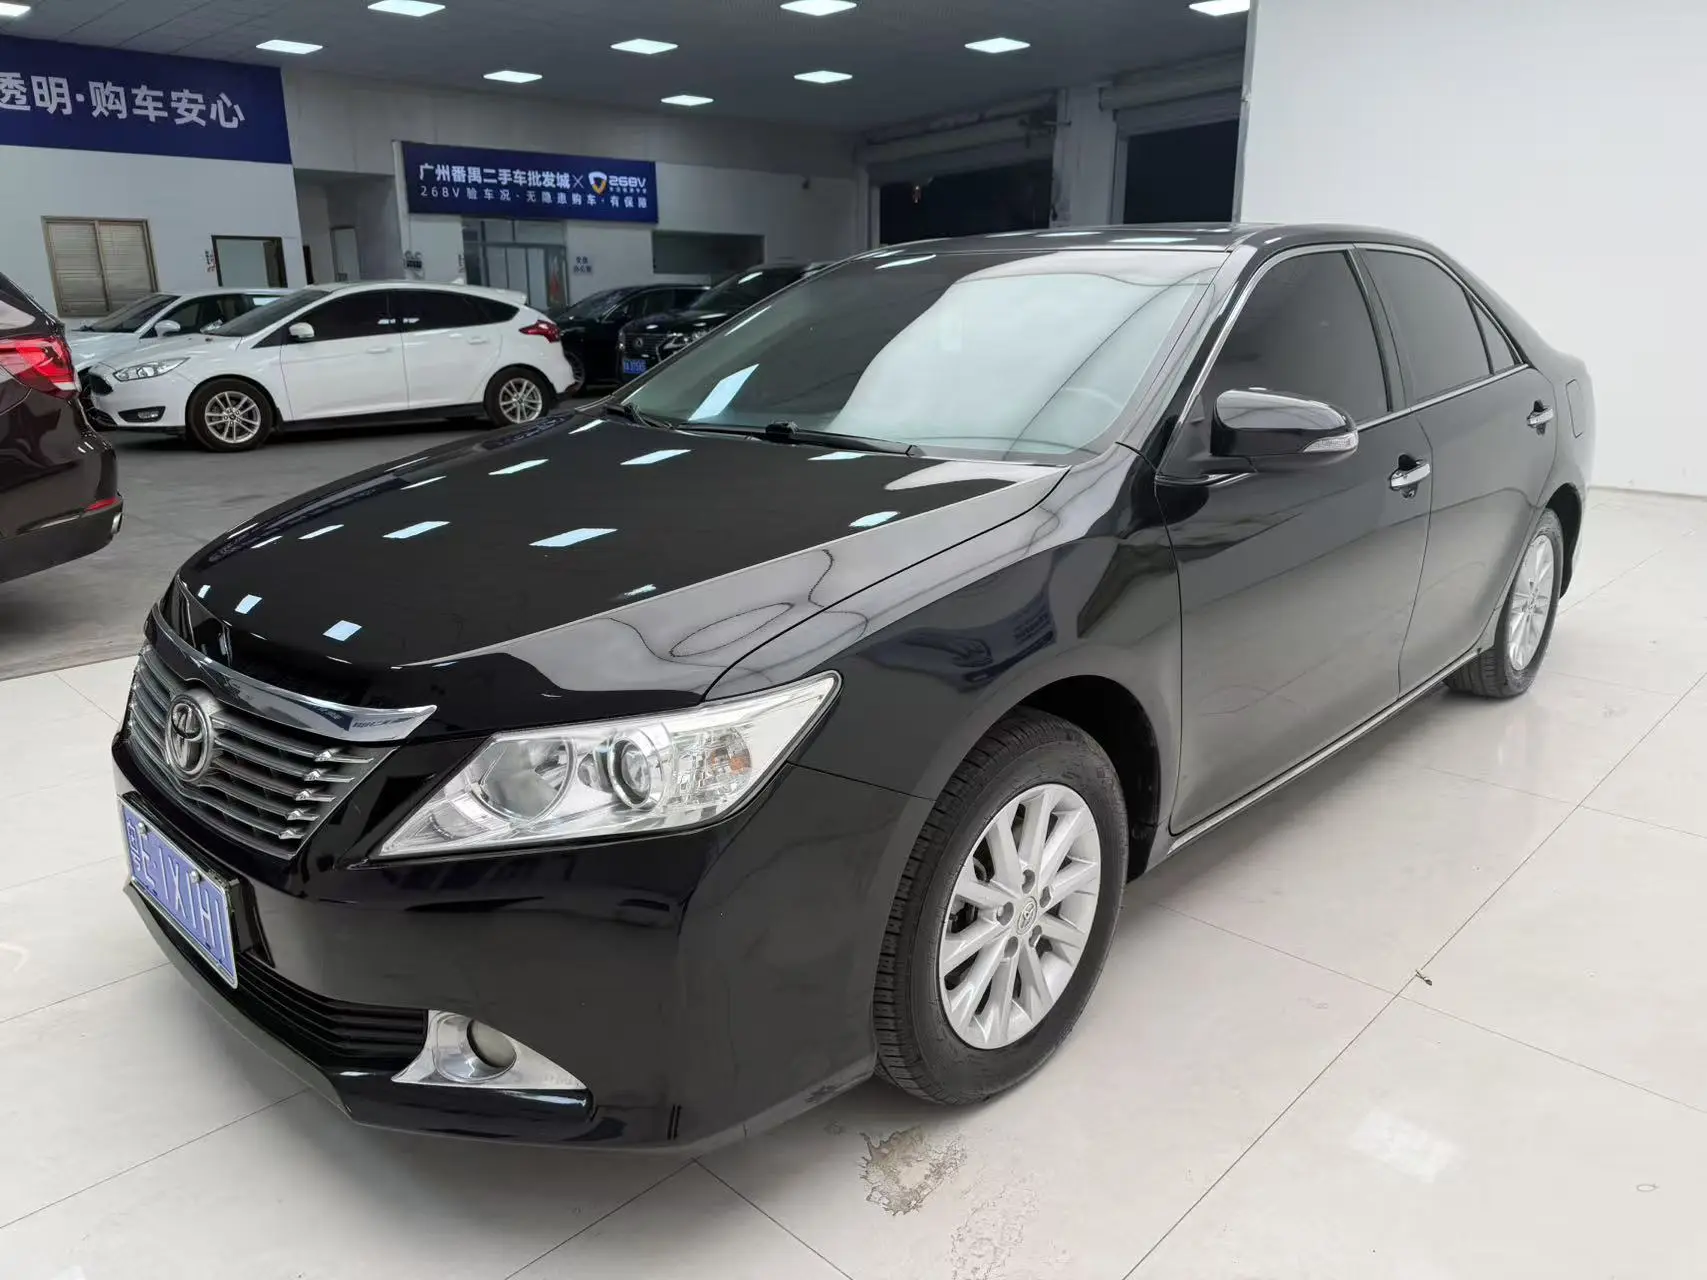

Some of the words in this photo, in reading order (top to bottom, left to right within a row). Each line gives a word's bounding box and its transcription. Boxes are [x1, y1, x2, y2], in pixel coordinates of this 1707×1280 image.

[0, 71, 246, 129] 透明·购车安心
[608, 175, 646, 188] 268V
[420, 185, 460, 198] 268V
